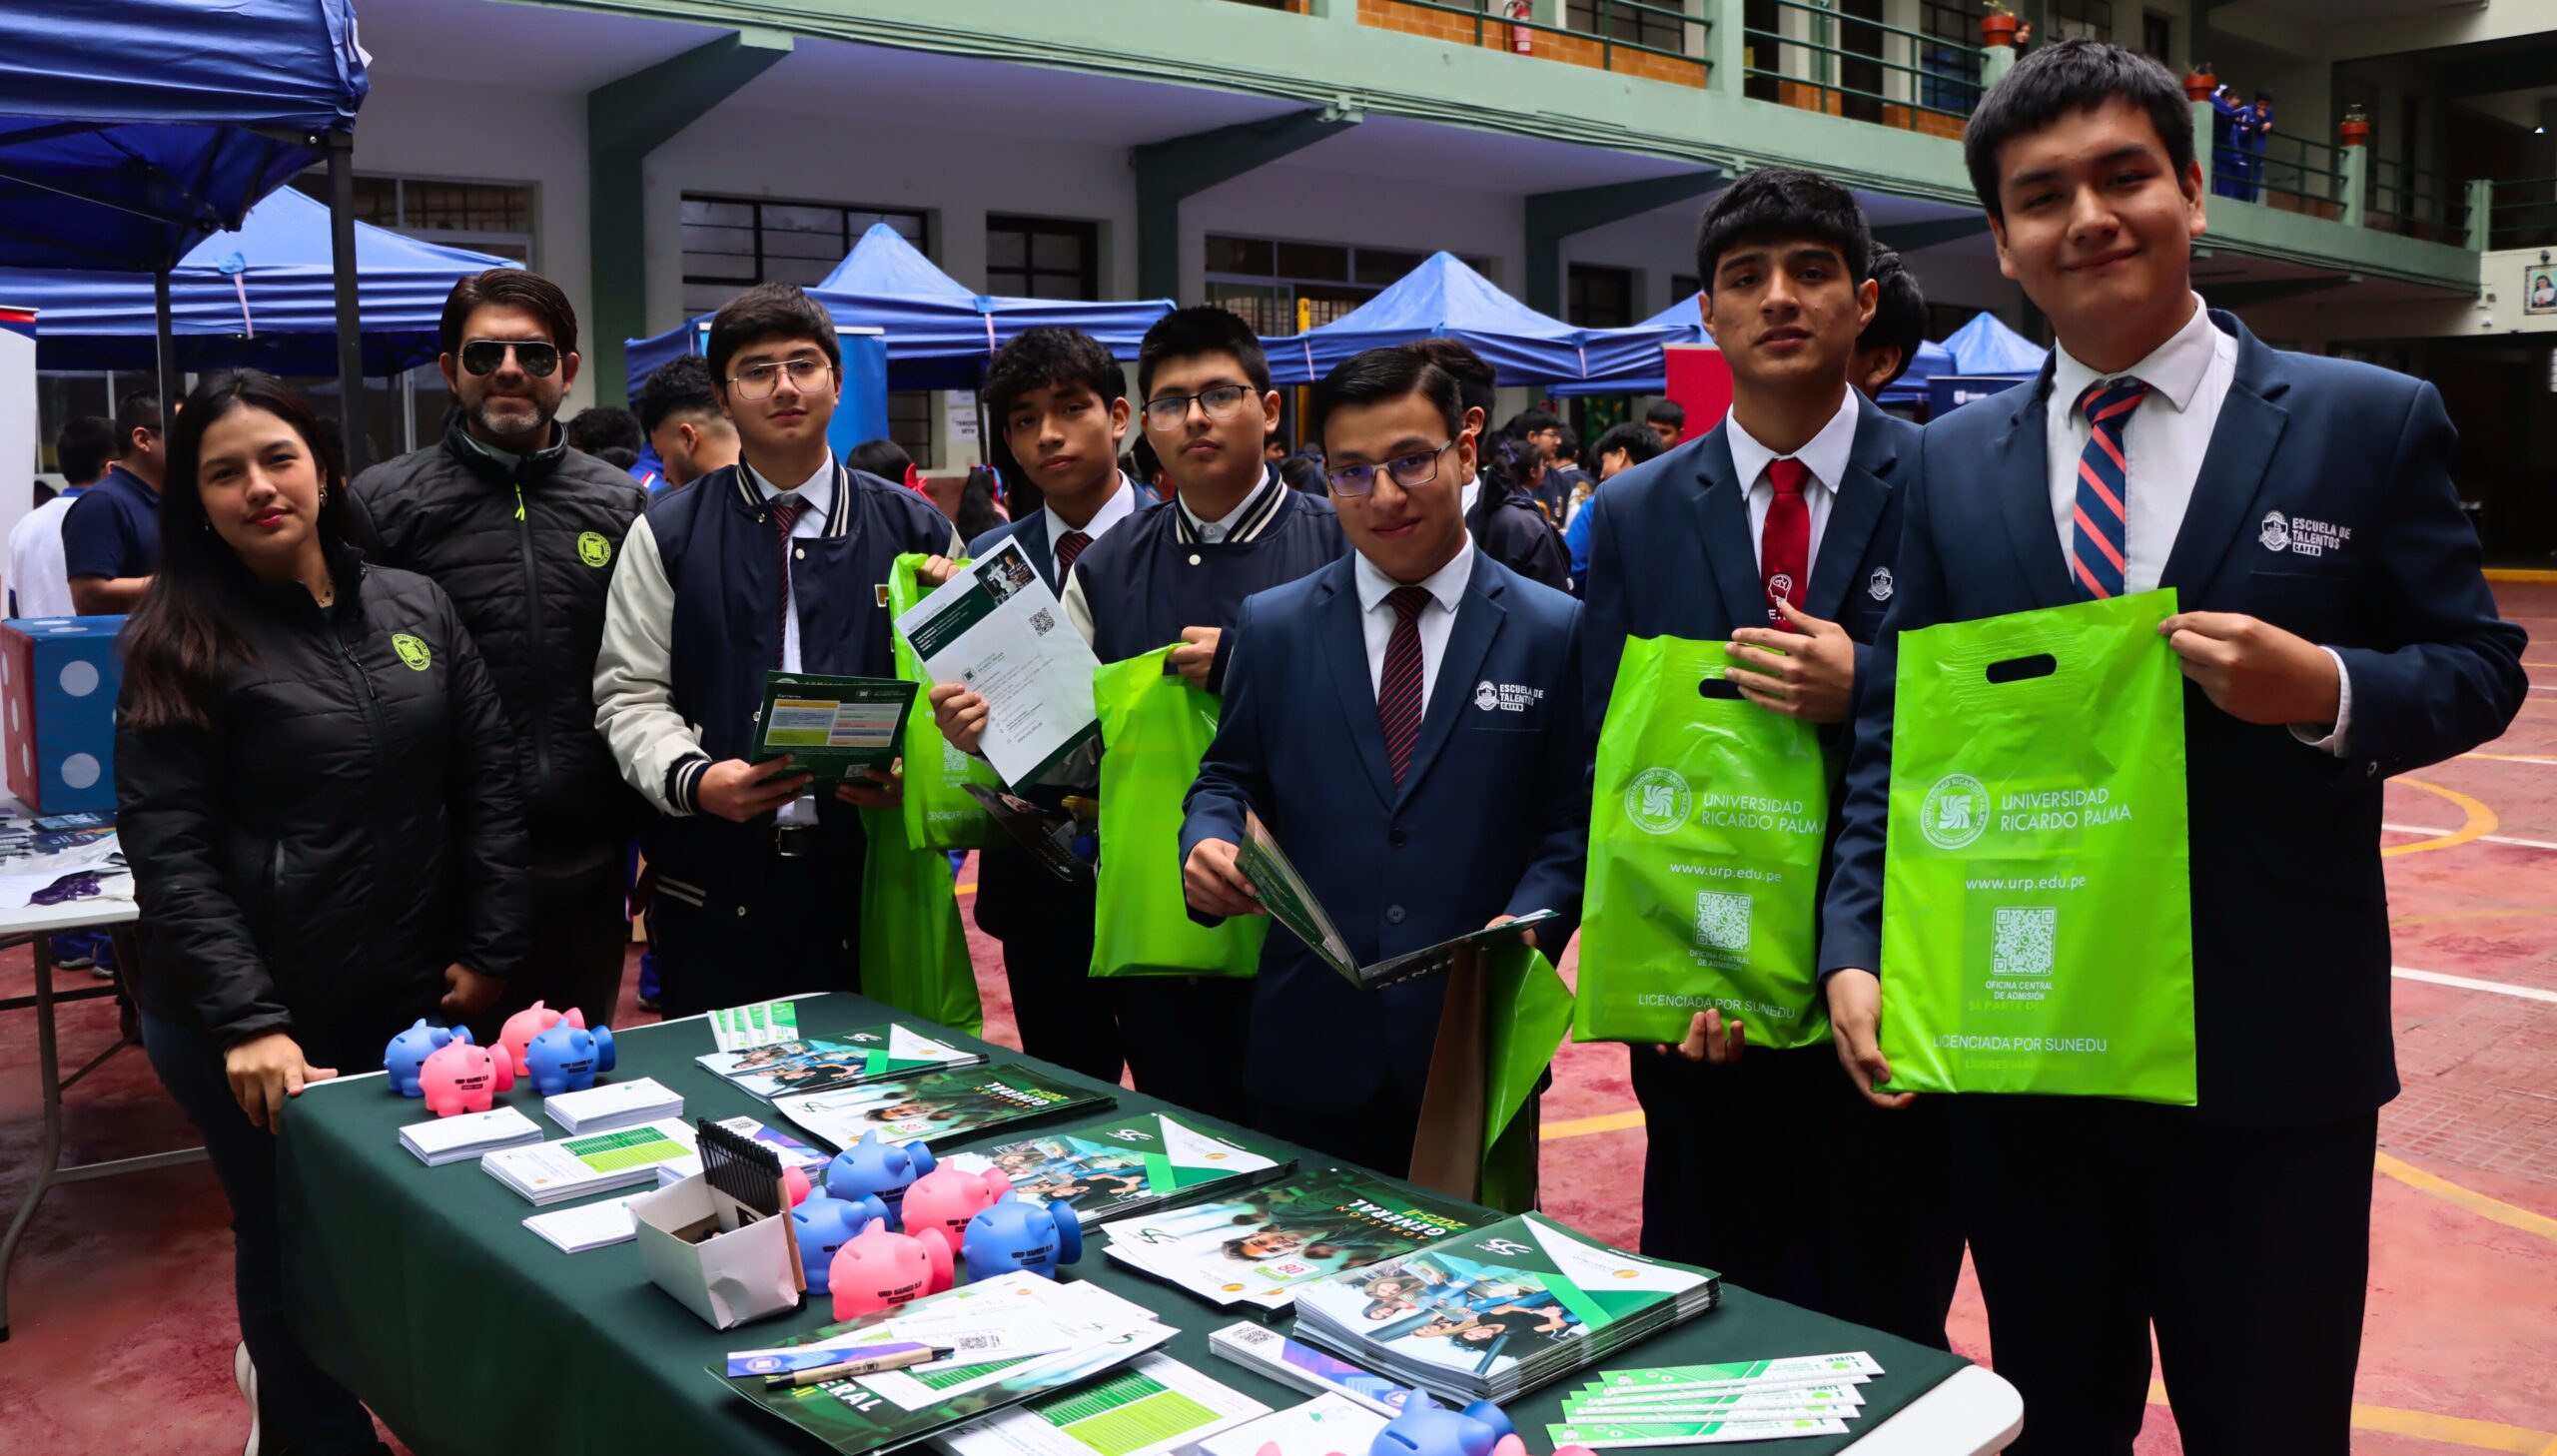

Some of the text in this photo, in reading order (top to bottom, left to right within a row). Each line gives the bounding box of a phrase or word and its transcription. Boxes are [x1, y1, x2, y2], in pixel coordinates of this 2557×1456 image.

[2291, 517, 2351, 539] ESCUELA DE
[2291, 529, 2340, 549] TALENTOS
[1499, 684, 1544, 698] ESCUELA DE
[1499, 693, 1534, 706] TALENTOS
[1703, 793, 1803, 814] UNIVERSIDAD
[2001, 788, 2109, 811] UNIVERSIDAD
[1701, 811, 1773, 831] RICARDO
[2001, 803, 2132, 832] RICARDO PALMA
[1670, 863, 1782, 883] www.urp.edu.pe
[1966, 875, 2086, 892] www.urp.edu.pe
[1985, 981, 2053, 991] OFICINA CENTRAL
[1638, 994, 1796, 1019] LICENCIADA POR SUNEDU
[1933, 1035, 2108, 1053] LICENCIADA POR SUNEDU
[1348, 1198, 1446, 1236] GENERAL
